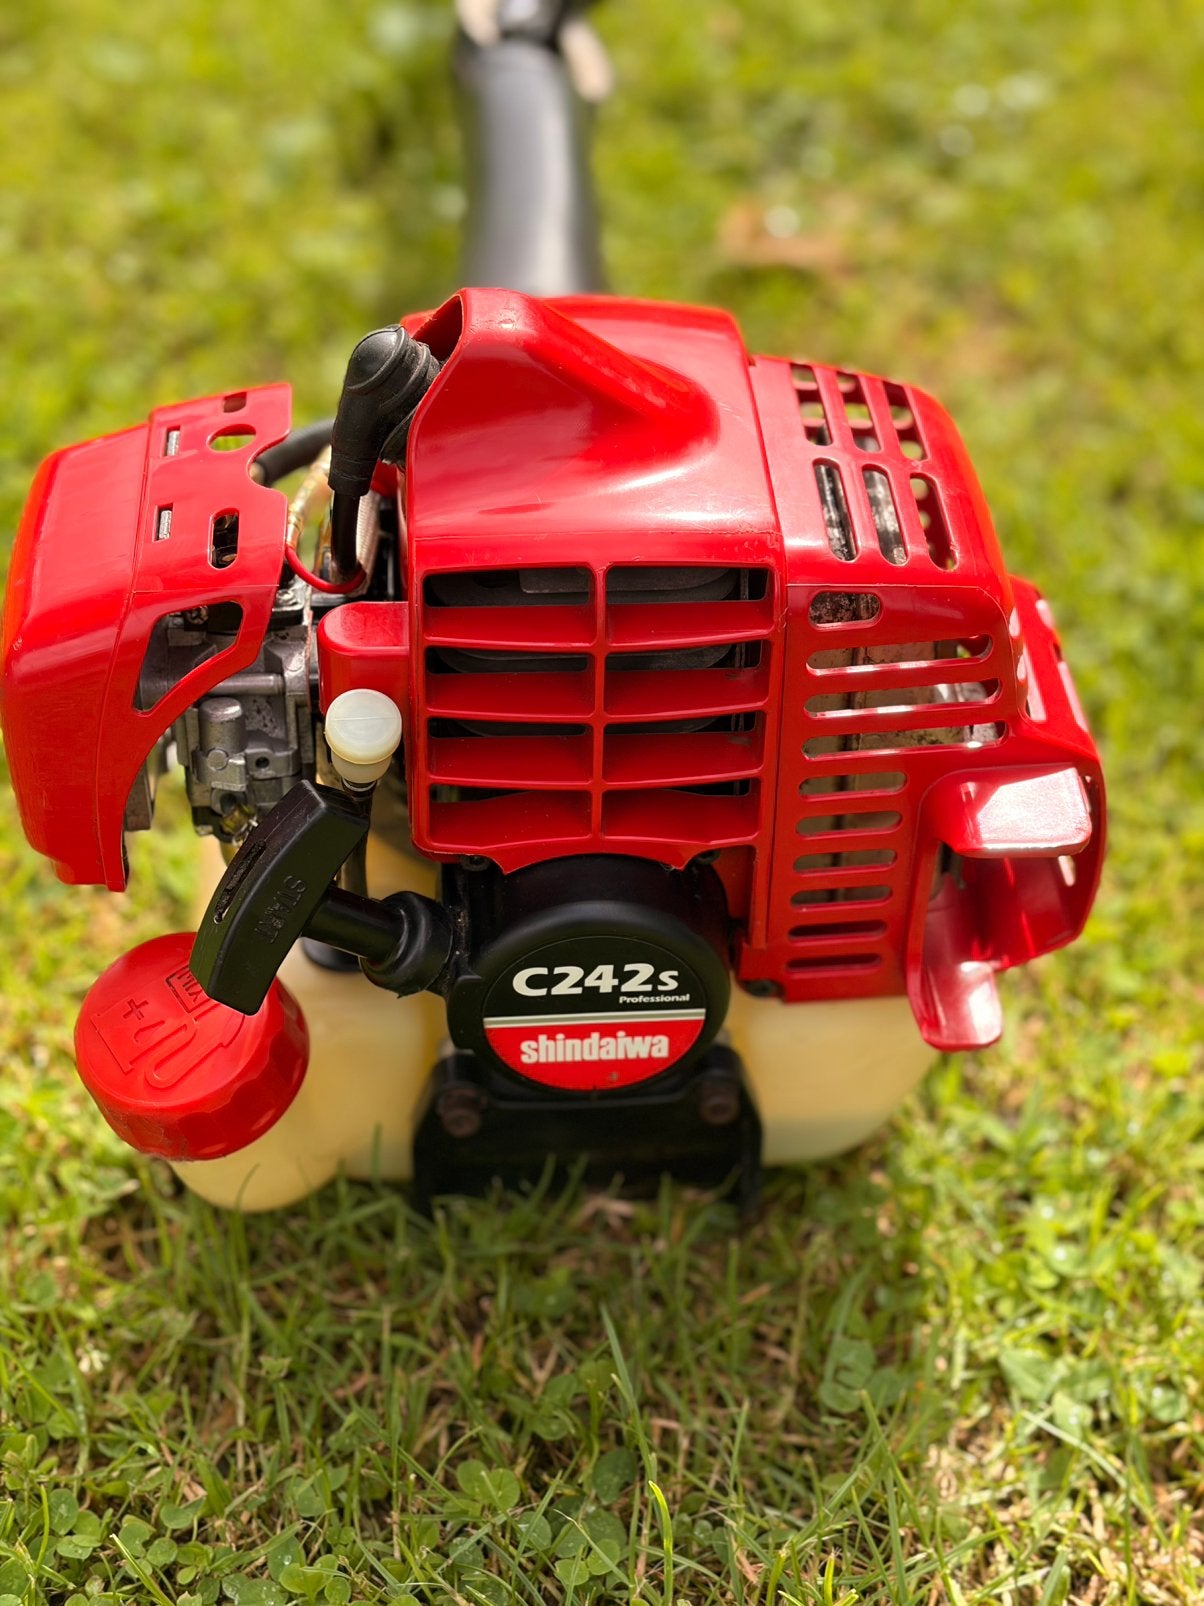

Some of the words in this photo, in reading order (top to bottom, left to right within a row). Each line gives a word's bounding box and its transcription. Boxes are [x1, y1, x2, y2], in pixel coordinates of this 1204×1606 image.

[254, 875, 307, 944] START
[619, 993, 690, 1004] Professional
[520, 1031, 669, 1064] shindaiwa
